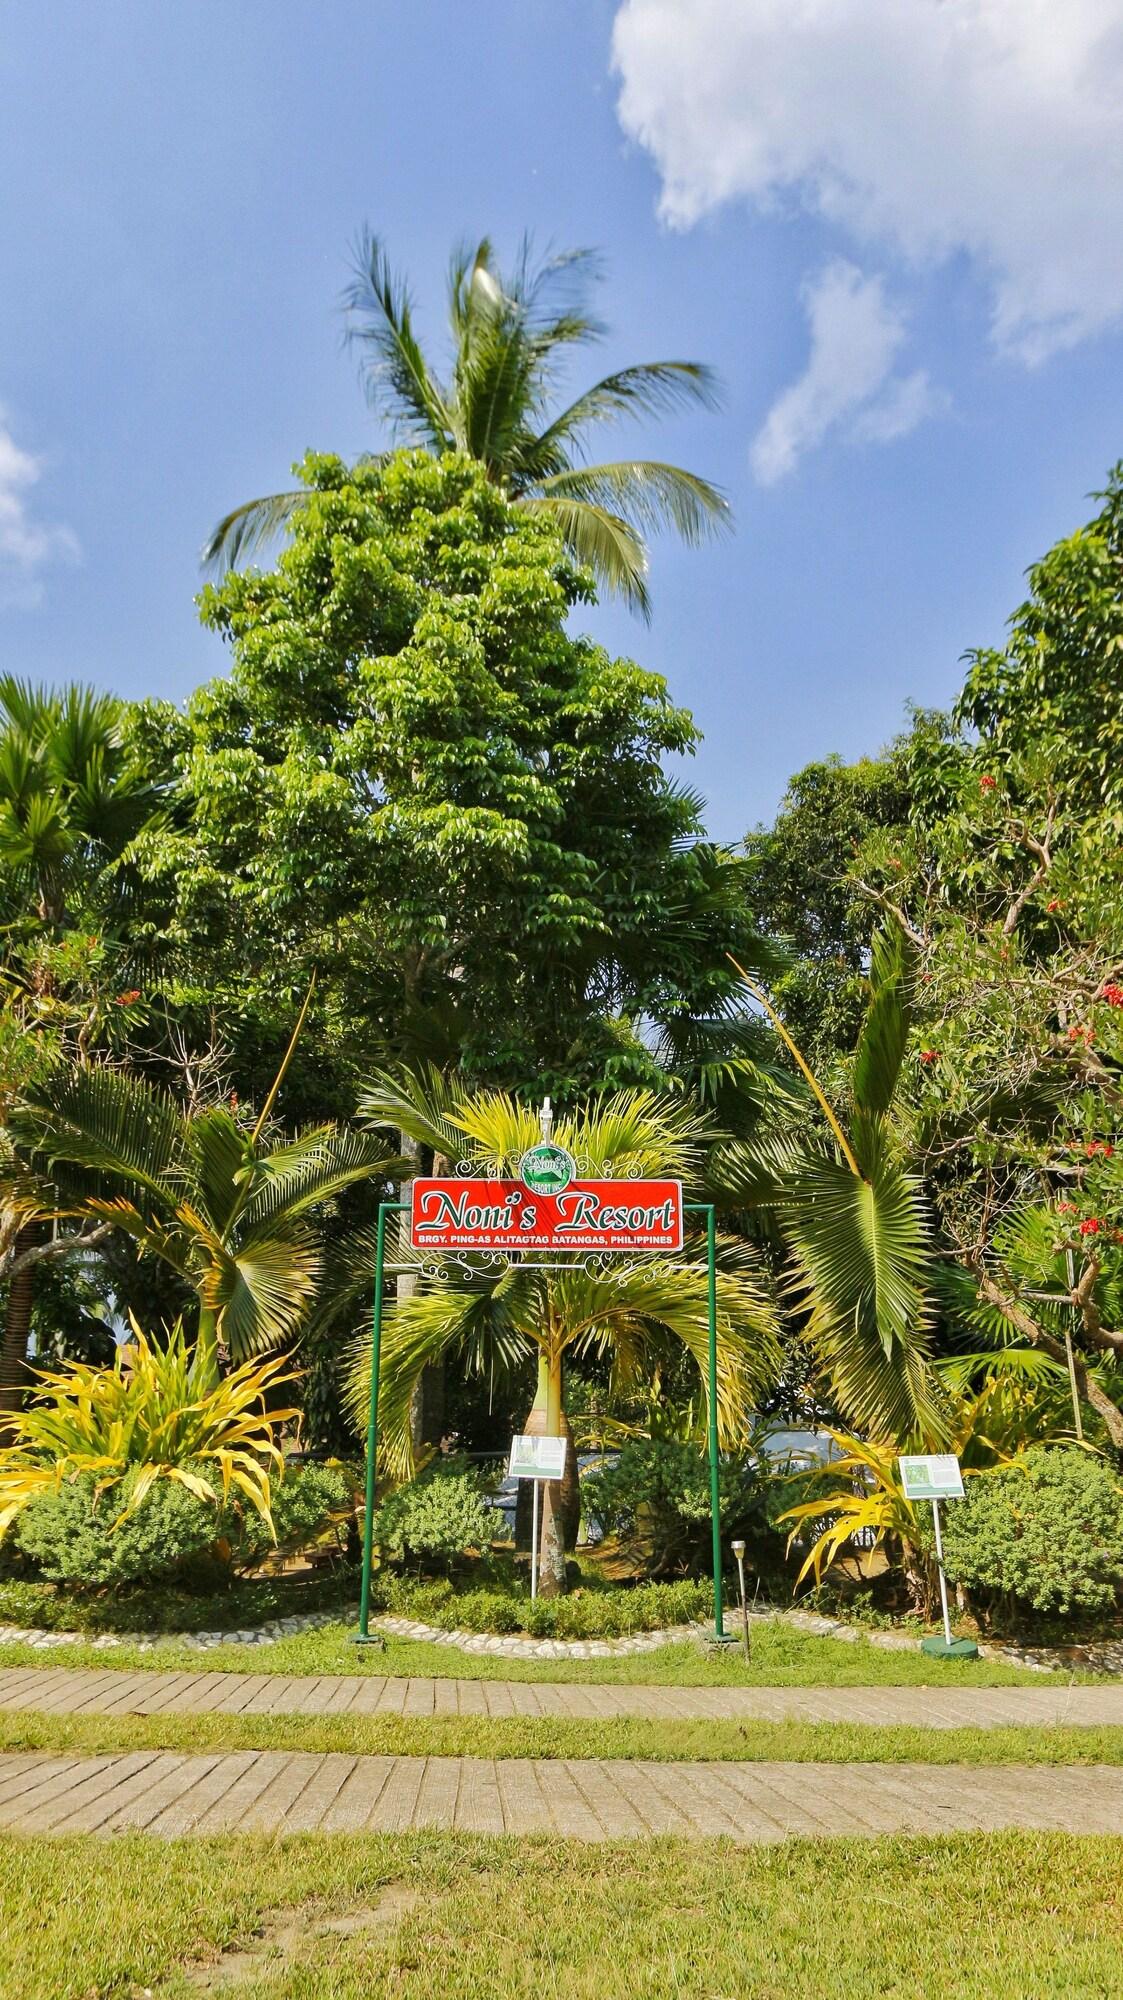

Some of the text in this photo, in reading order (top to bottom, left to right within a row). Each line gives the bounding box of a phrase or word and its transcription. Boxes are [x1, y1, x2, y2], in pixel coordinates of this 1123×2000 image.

[528, 1155, 566, 1170] Noni's
[415, 1191, 676, 1232] Noni's Resort
[418, 1235, 673, 1245] BRGY. PING-AS ALITAGTAG BATANGAS, PHILIPPINES
